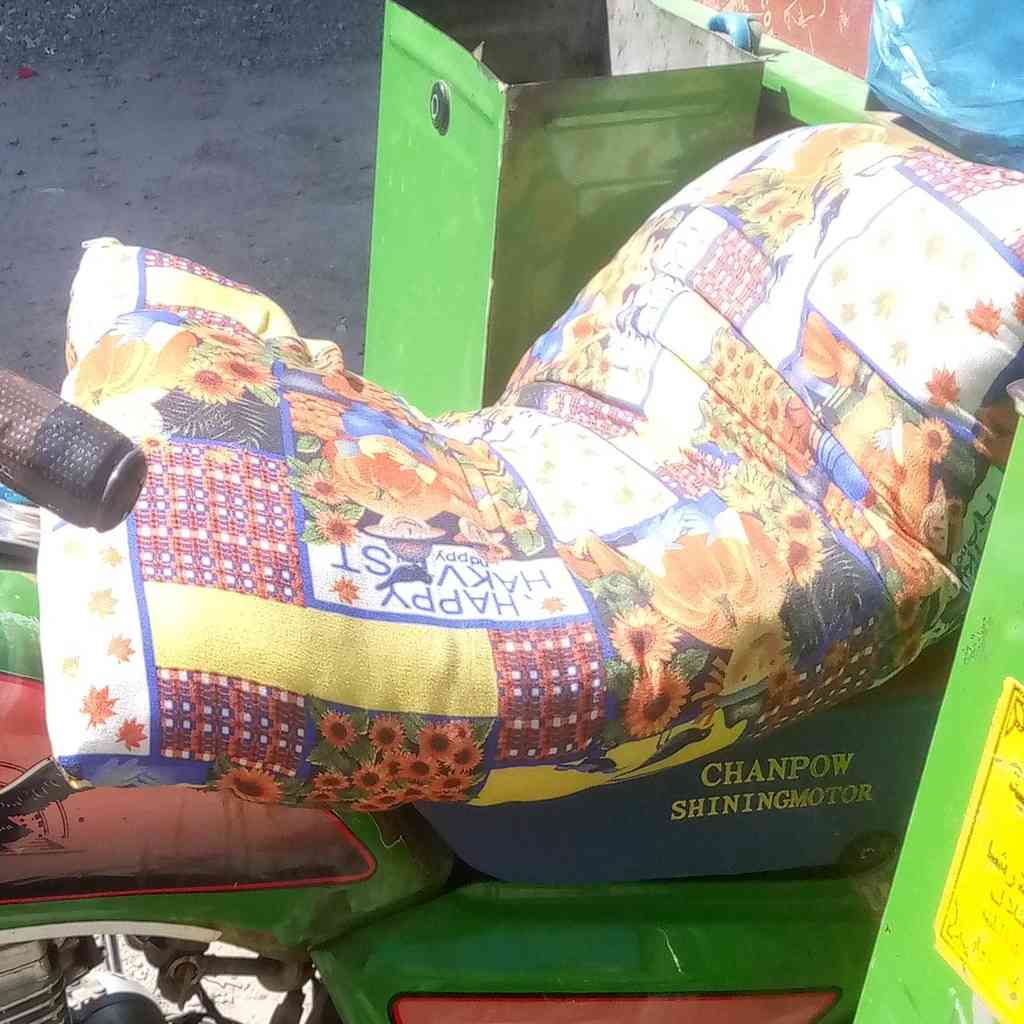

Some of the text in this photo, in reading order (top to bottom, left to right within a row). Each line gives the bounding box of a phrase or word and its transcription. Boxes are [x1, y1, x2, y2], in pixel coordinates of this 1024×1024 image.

[380, 584, 520, 616] HAPPY
[700, 753, 856, 787] CHANPOW
[670, 784, 873, 821] SHININGMOTOR
